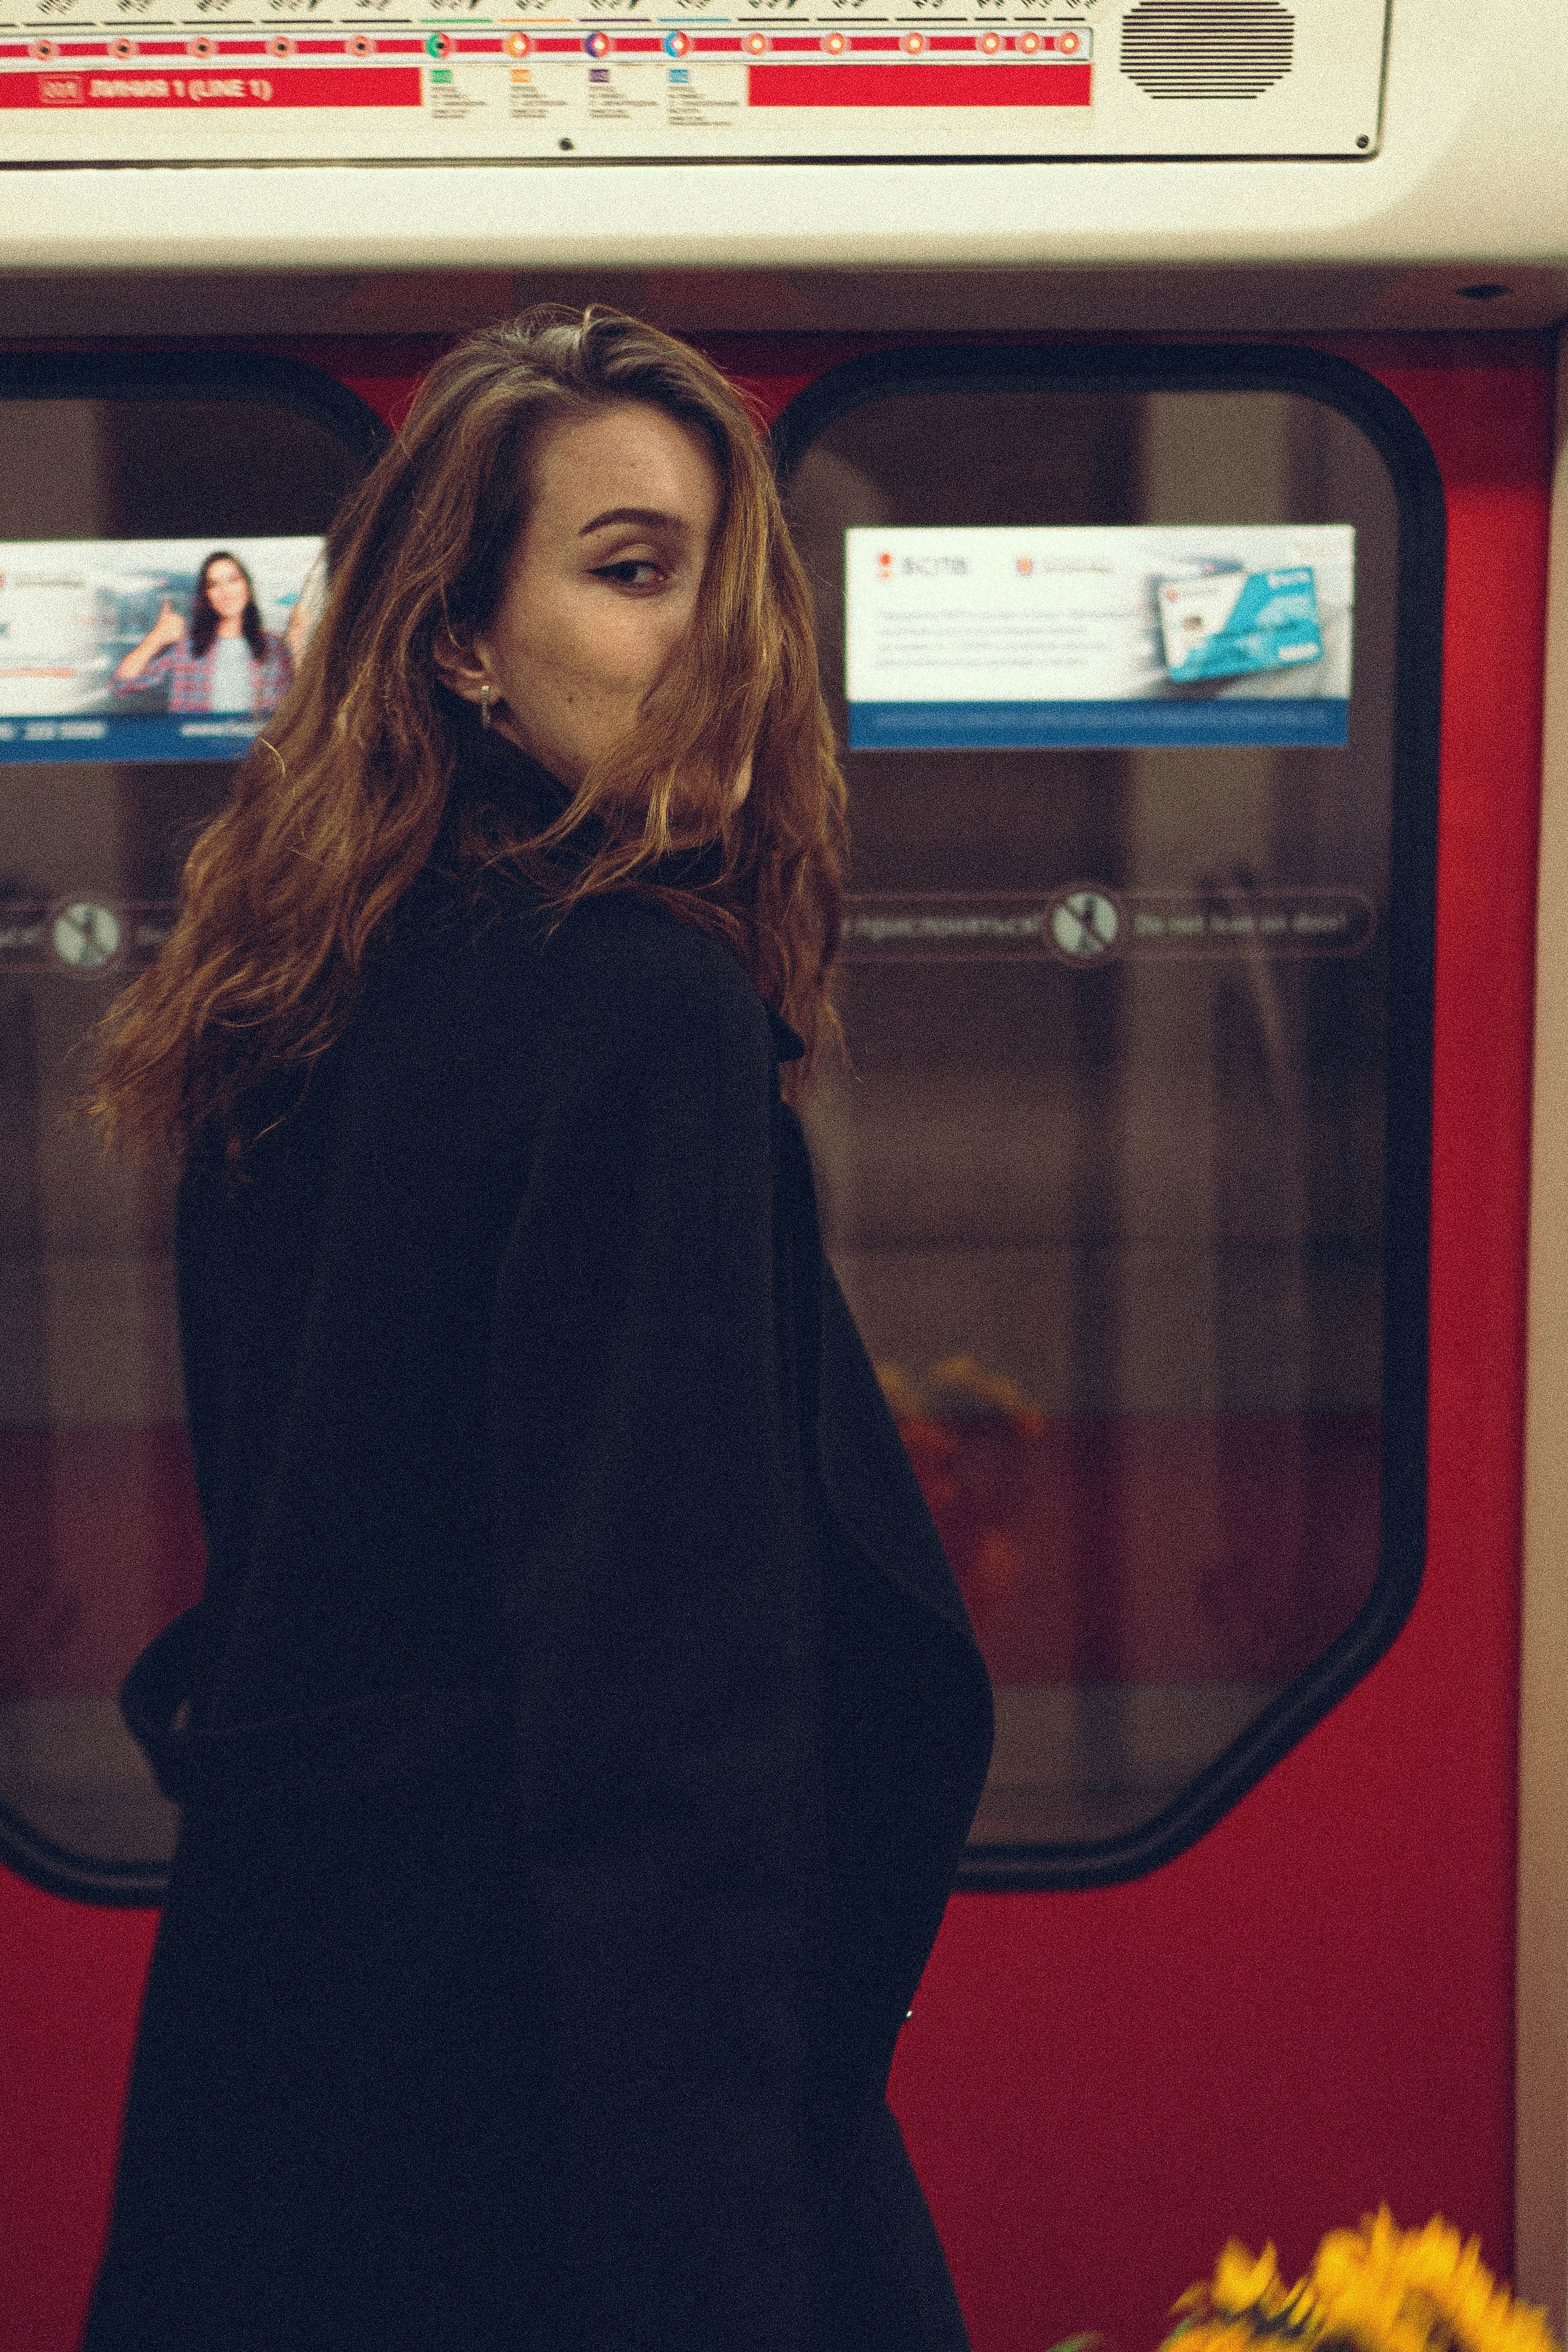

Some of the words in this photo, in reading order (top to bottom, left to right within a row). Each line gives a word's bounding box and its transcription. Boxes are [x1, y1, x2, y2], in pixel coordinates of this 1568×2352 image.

[172, 79, 185, 97] 1
[189, 79, 247, 102] (LINE
[249, 79, 273, 102] 1)
